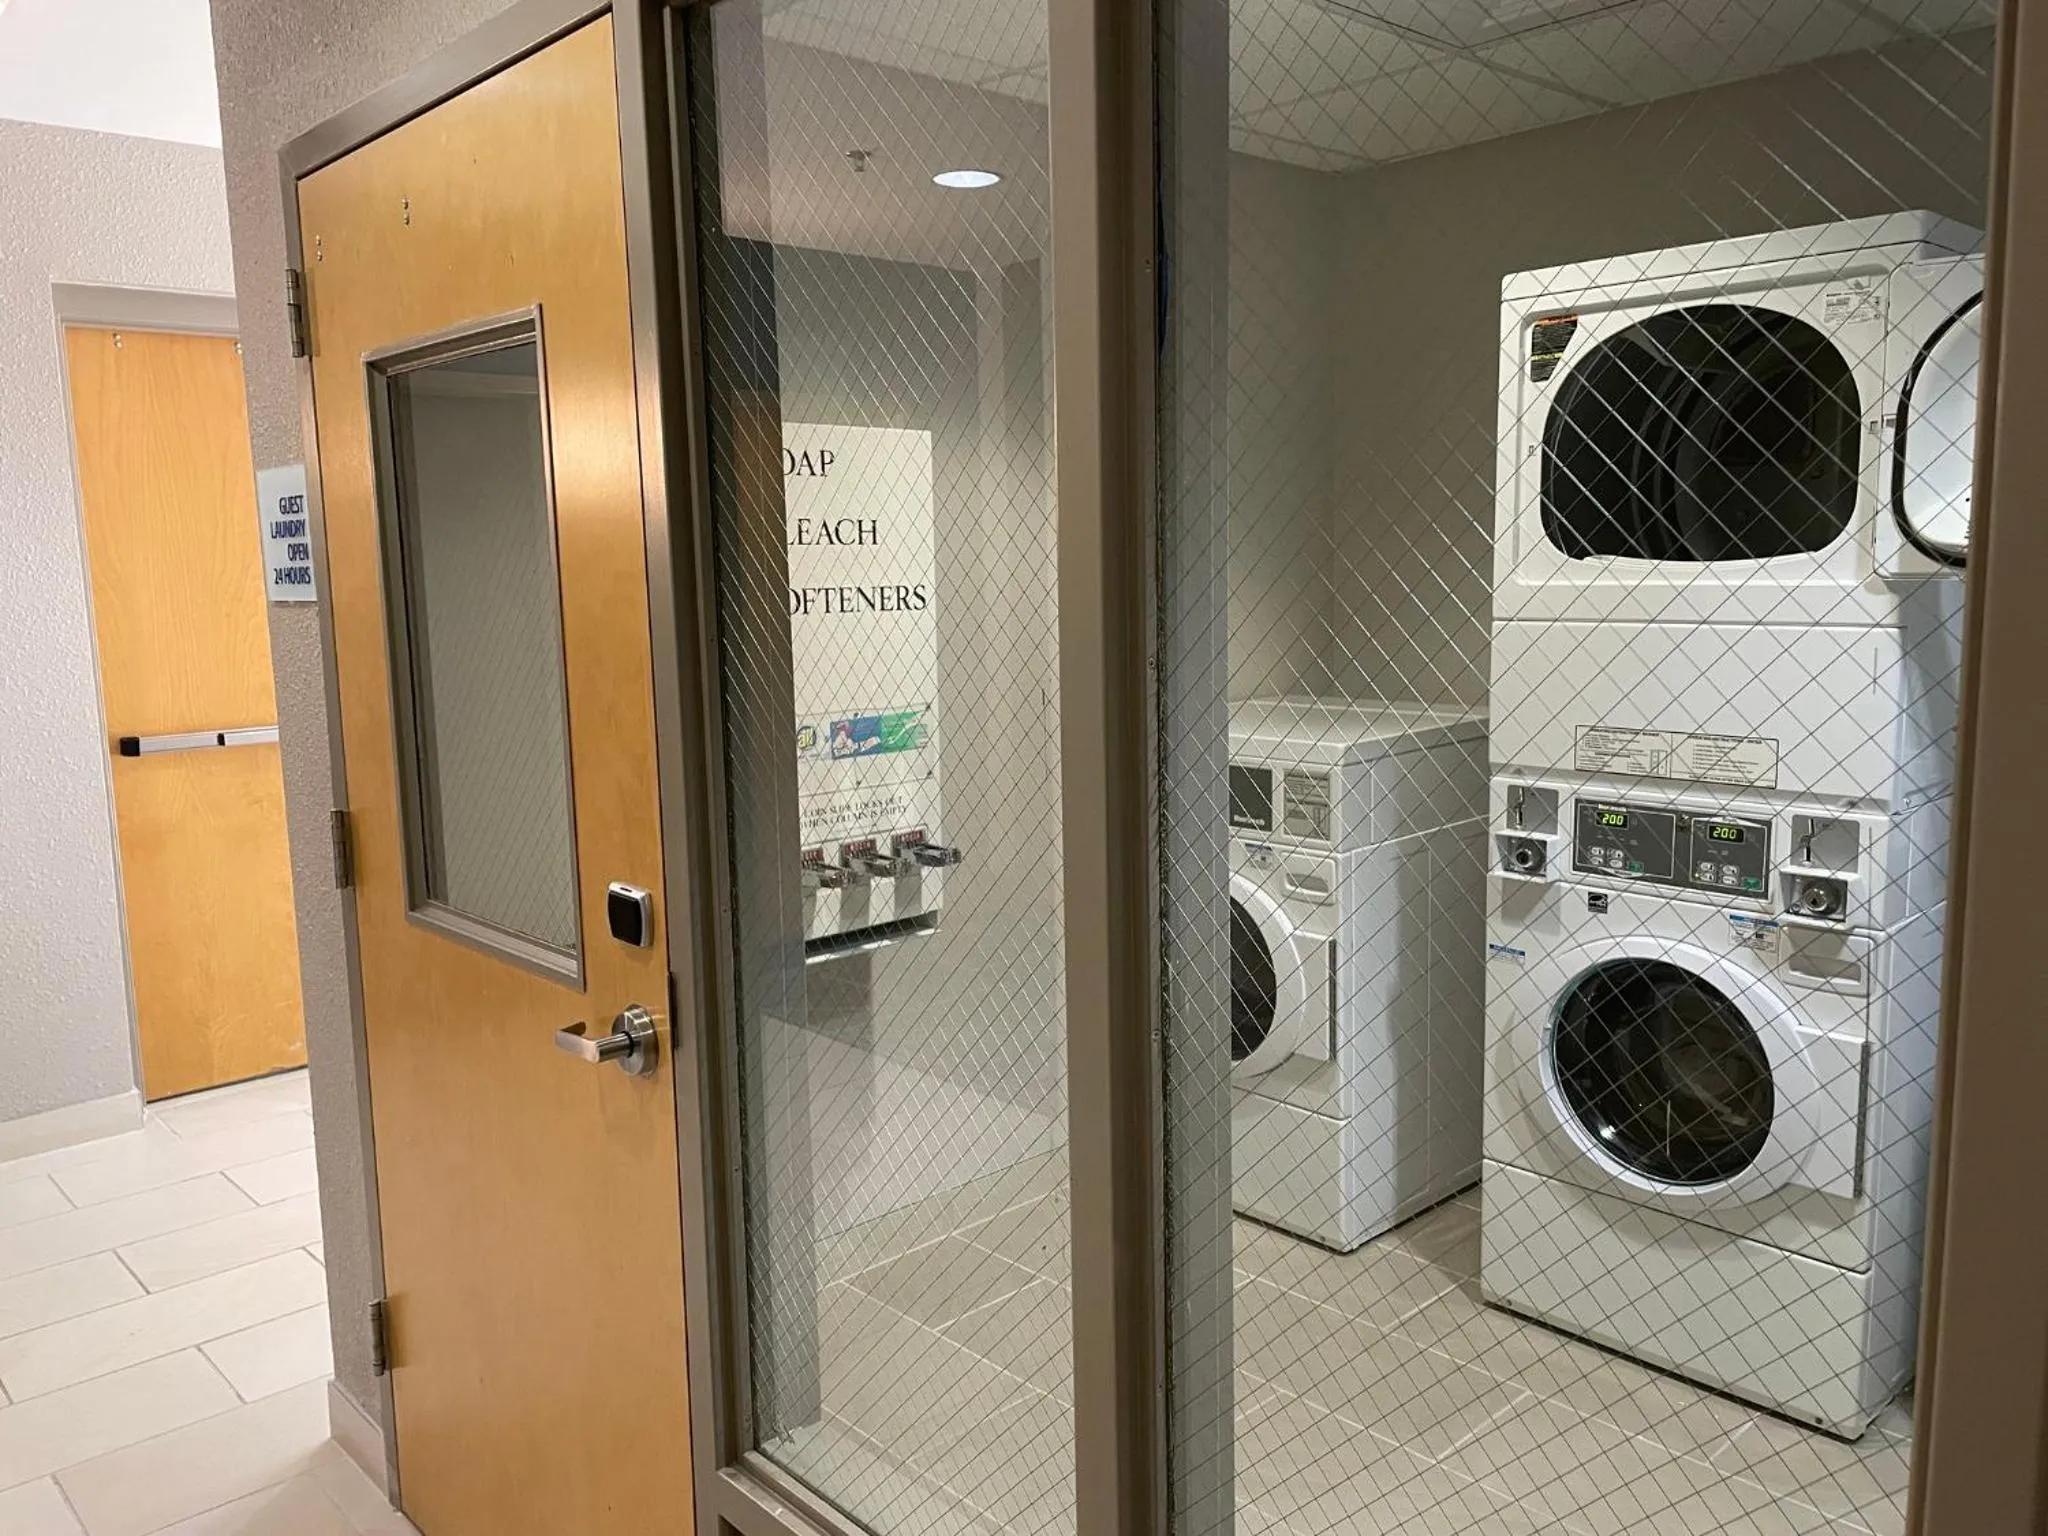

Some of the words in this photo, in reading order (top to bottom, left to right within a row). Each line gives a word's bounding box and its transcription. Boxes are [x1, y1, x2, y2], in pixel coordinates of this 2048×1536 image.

[279, 495, 304, 514] GUEST
[270, 519, 306, 539] LAUNDRY
[788, 518, 879, 545] EACH
[287, 543, 310, 562] OPEN
[273, 568, 284, 585] 24
[284, 566, 311, 584] HOURS
[1602, 813, 1625, 826] 200
[1712, 826, 1738, 839] 200
